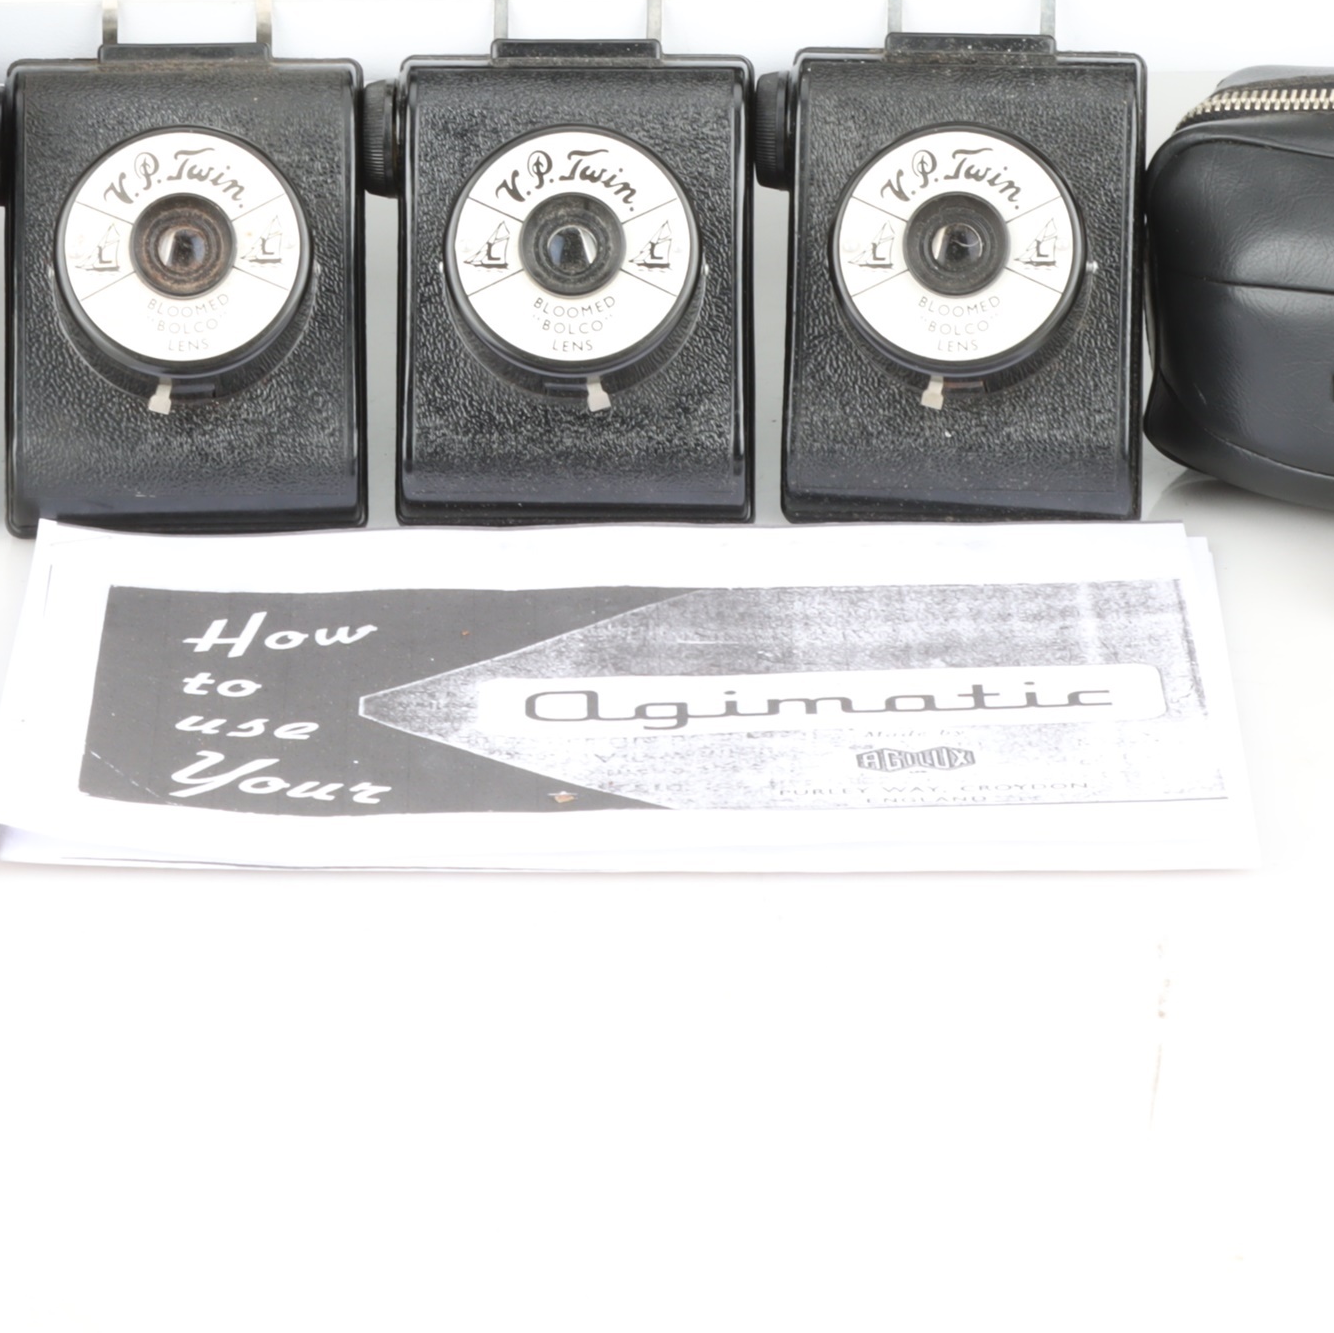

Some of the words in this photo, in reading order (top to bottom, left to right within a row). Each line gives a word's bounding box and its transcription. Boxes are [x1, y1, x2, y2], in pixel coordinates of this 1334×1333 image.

[147, 293, 230, 318] BLOOMED
[533, 295, 616, 319] BLOOMED
[918, 295, 1001, 318] BLOOMED
[168, 338, 210, 352] LENS
[552, 339, 594, 352] LENS
[937, 339, 979, 352] LENS
[182, 611, 379, 658] How
[182, 672, 263, 698] to
[174, 715, 320, 740] use
[855, 745, 977, 773] AGILUX
[168, 750, 392, 804] Your
[778, 787, 870, 797] PURLEY
